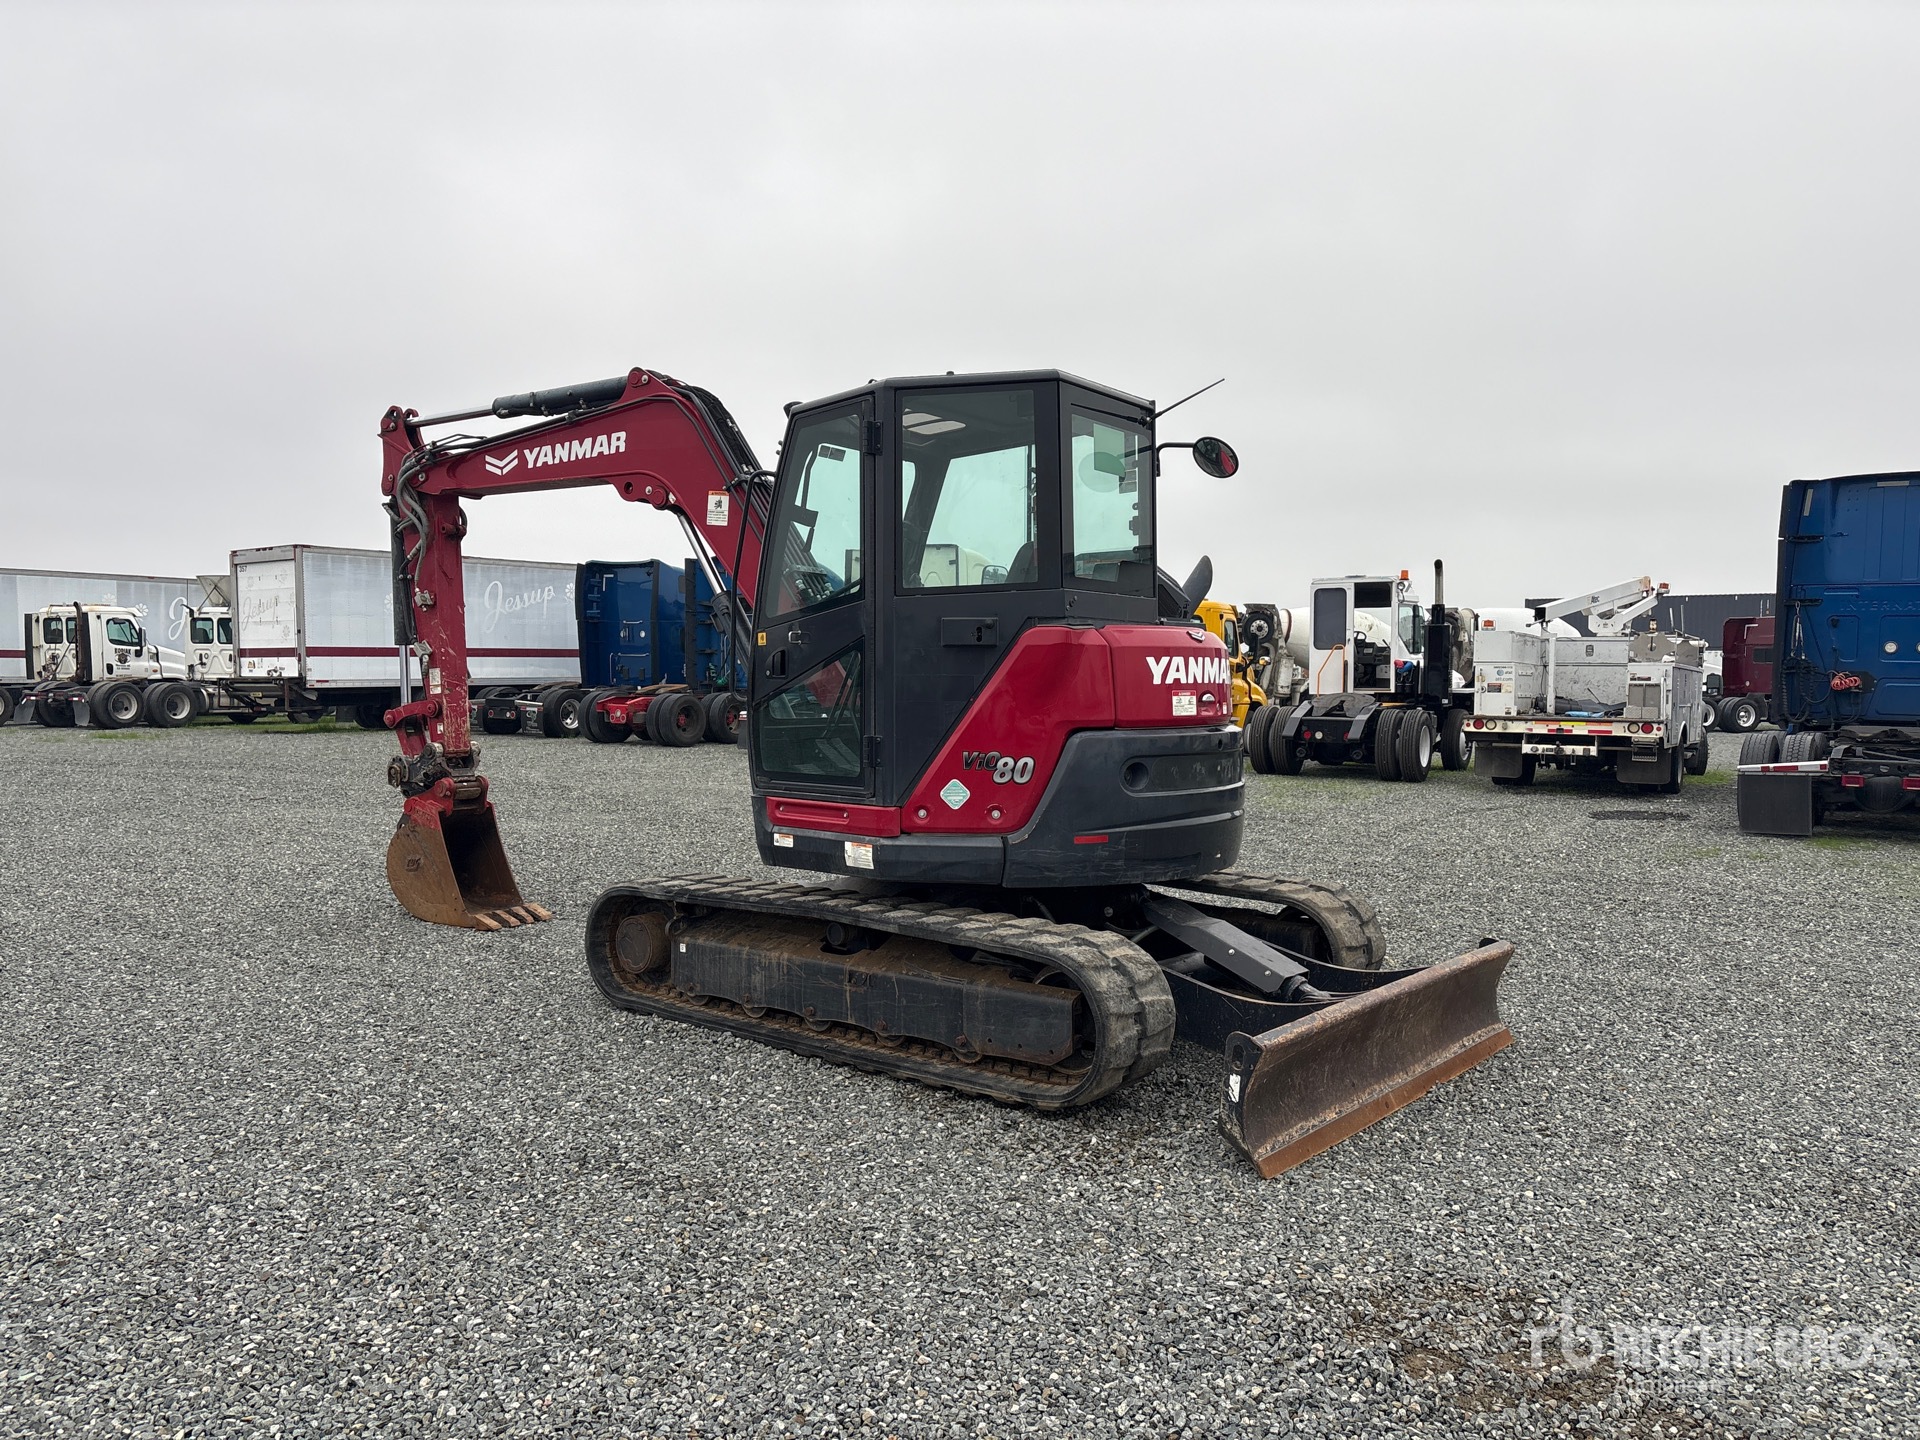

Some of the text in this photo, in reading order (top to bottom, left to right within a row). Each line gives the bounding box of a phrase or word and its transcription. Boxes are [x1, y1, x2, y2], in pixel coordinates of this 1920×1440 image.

[523, 431, 627, 469] YANMAR
[239, 565, 247, 573] 357
[241, 595, 279, 631] Jessup
[484, 581, 556, 633] Jessup
